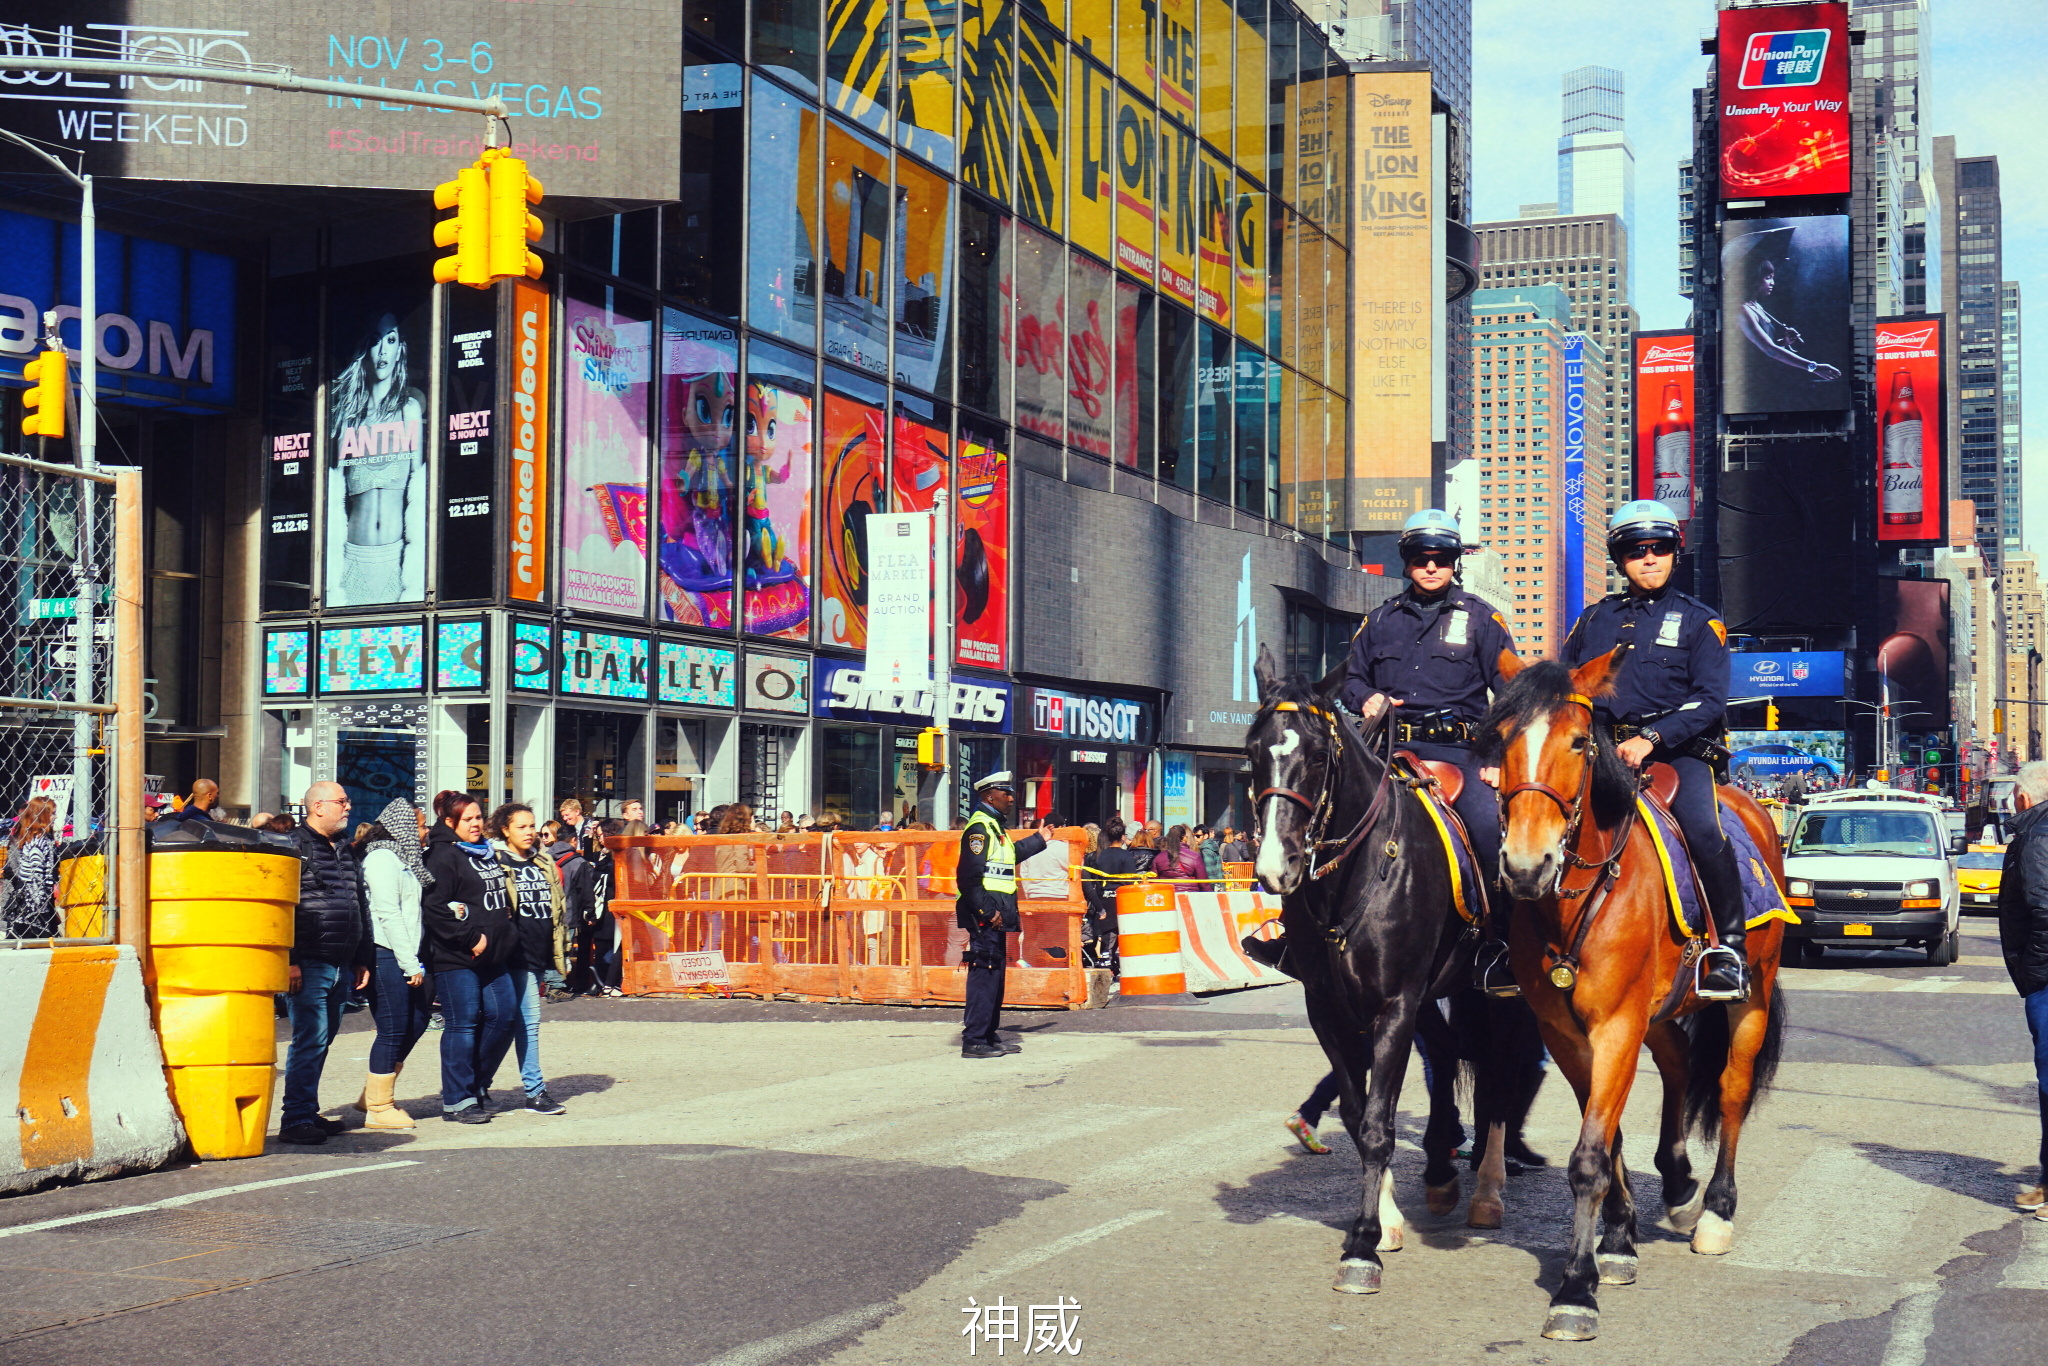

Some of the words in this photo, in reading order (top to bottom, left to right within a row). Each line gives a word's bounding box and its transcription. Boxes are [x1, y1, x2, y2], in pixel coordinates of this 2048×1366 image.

[327, 34, 409, 70] NOV
[1751, 45, 1820, 63] UnionPay
[1776, 60, 1813, 74] 银联
[327, 75, 362, 109] IN
[380, 79, 457, 114] LAS
[471, 82, 604, 120] VEGAS
[1367, 93, 1412, 110] Disney
[1726, 103, 1780, 117] UnionPay
[1782, 101, 1811, 113] Your
[1814, 99, 1842, 113] Way
[58, 109, 249, 147] WEEKEND
[1082, 34, 1169, 213] LION
[1371, 125, 1410, 144] THE
[1364, 149, 1418, 181] LION
[1177, 108, 1254, 268] KING
[1360, 183, 1427, 222] KING
[1118, 242, 1152, 274] ENTRANCE
[1161, 269, 1173, 286] ON
[1175, 275, 1192, 296] 45TH
[1199, 289, 1218, 312] STREET
[1410, 300, 1422, 313] IS
[1373, 319, 1417, 332] SIMPLY
[461, 341, 482, 351] NEXT
[1358, 338, 1428, 351] NOTHING
[464, 350, 479, 359] TOP
[457, 357, 485, 369] MODEL
[1379, 355, 1406, 369] ELSE
[1676, 364, 1689, 372] FOR
[1373, 374, 1396, 388] LIKE
[1565, 350, 1584, 462] NOVOTEL
[450, 410, 491, 431] NEXT
[339, 419, 419, 460] ANTM
[450, 431, 457, 441] IS
[457, 429, 476, 440] NOW
[477, 427, 489, 437] ON
[274, 433, 311, 452] NEXT
[511, 310, 538, 584] nickelodeon
[274, 452, 281, 461] IS
[281, 450, 299, 460] NOW
[299, 449, 310, 459] ON
[338, 457, 368, 468] AMERICA'S
[368, 455, 384, 464] NEXT
[384, 454, 397, 462] TOP
[397, 452, 419, 462] MODEL
[1374, 488, 1397, 497] GET
[448, 503, 490, 517] 12.12.16
[1362, 499, 1409, 508] TICKETS
[1368, 512, 1403, 521] HERE!
[271, 519, 309, 533] 12.12.16
[878, 554, 920, 567] FLEA
[568, 569, 589, 586] NEW
[590, 573, 635, 594] PRODUCTS
[871, 569, 926, 581] MARKET
[566, 585, 612, 605] AVAILABLE
[613, 591, 637, 609] NOW!
[878, 594, 920, 603] GRAND
[41, 602, 50, 616] W
[54, 602, 66, 615] 44
[873, 605, 925, 615] AUCTION
[1794, 669, 1807, 678] NFL
[1066, 696, 1140, 740] TISSOT
[1209, 711, 1228, 724] ONE
[903, 762, 909, 771] GO
[1748, 756, 1780, 765] HYUNDAI
[1781, 756, 1814, 765] ELANTRA
[518, 890, 534, 903] IN
[680, 956, 712, 968] CLOSED
[677, 967, 725, 981] CROSSWALK
